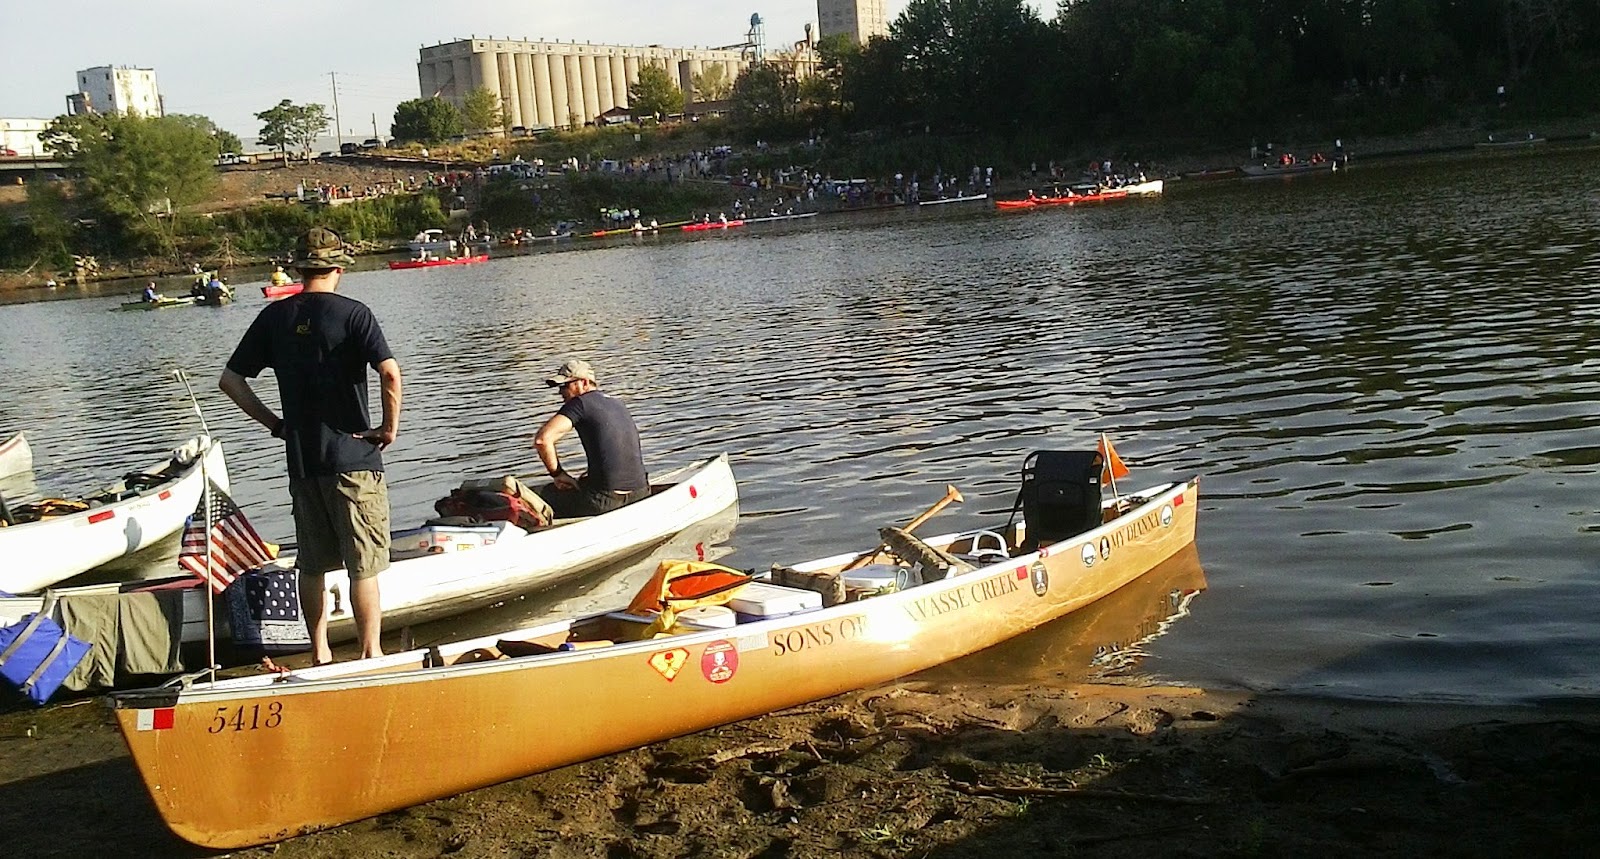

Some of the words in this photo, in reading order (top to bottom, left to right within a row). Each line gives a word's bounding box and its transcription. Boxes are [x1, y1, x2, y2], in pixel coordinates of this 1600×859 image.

[329, 582, 345, 617] 1
[773, 623, 834, 657] SONS
[839, 614, 868, 641] OF
[971, 574, 1019, 604] CREEK
[208, 701, 284, 734] 5413
